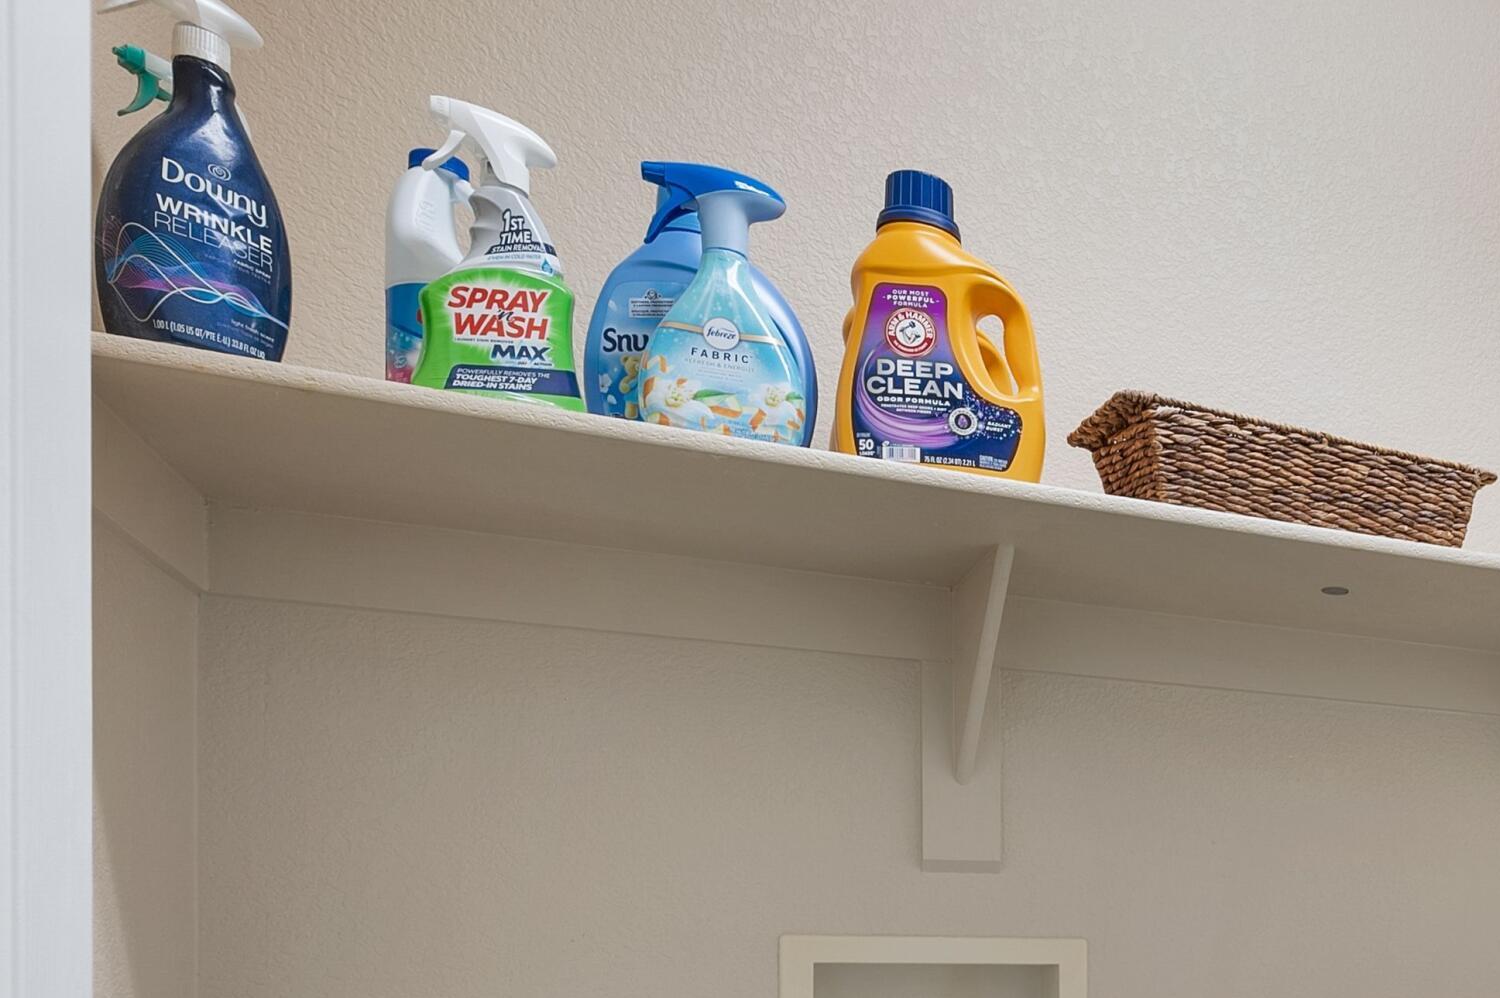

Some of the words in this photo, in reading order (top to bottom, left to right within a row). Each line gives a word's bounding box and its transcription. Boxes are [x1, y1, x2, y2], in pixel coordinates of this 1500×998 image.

[162, 156, 267, 228] Downy
[156, 193, 272, 254] WRINKLE
[503, 209, 525, 232] 1ST
[154, 211, 272, 271] RELEASER
[501, 231, 532, 245] TIME
[490, 244, 512, 254] STAIN
[448, 286, 548, 312] SPRAY
[887, 294, 935, 304] POWERFUL
[454, 312, 548, 340] WASH
[706, 326, 736, 340] febreze
[491, 344, 550, 361] MAX
[690, 347, 749, 364] FABRIC
[457, 367, 502, 376] POWERFULLY
[503, 370, 537, 378] REMOVES
[876, 358, 954, 379] DEEP
[452, 380, 497, 389] DRIED-IN
[498, 382, 533, 391] STAINS
[455, 373, 508, 383] TOUGHEST
[509, 376, 538, 385] 7-DAY
[866, 376, 963, 400] CLEAN
[859, 438, 874, 450] 50
